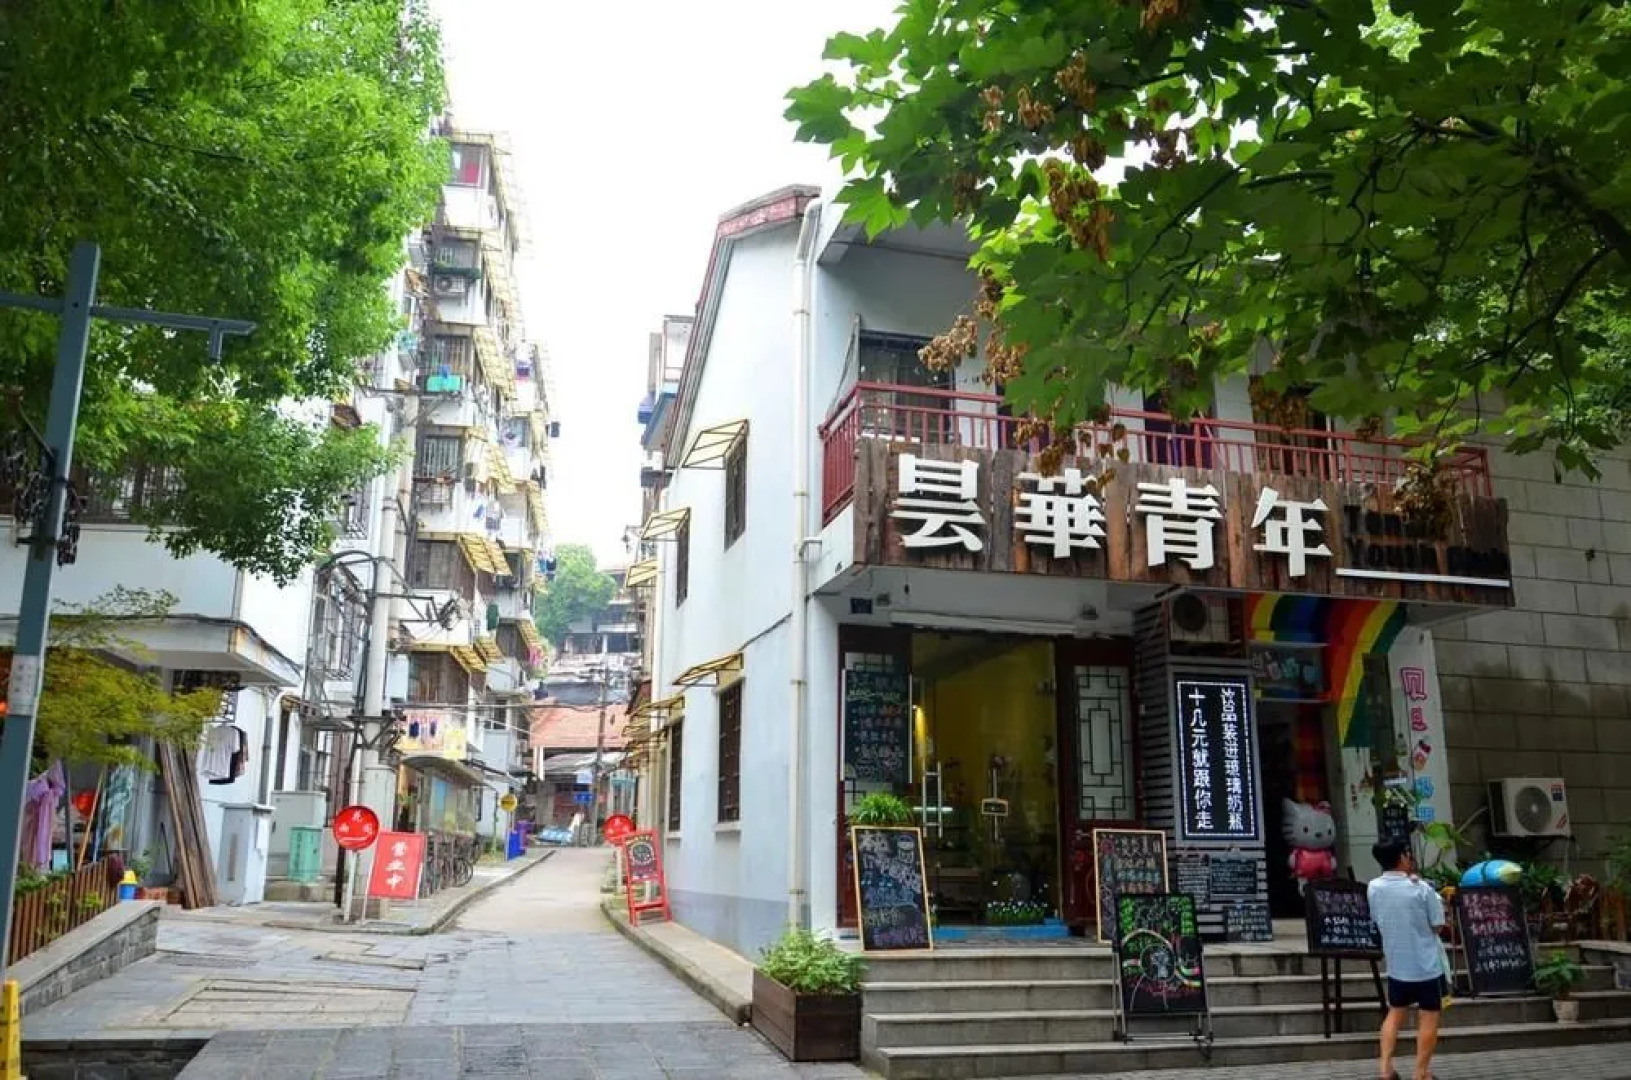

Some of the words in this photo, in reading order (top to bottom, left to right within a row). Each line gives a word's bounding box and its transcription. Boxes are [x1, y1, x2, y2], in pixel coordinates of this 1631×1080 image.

[889, 454, 1332, 577] 昙華青年
[1188, 687, 1214, 830] 十几元就跟你走
